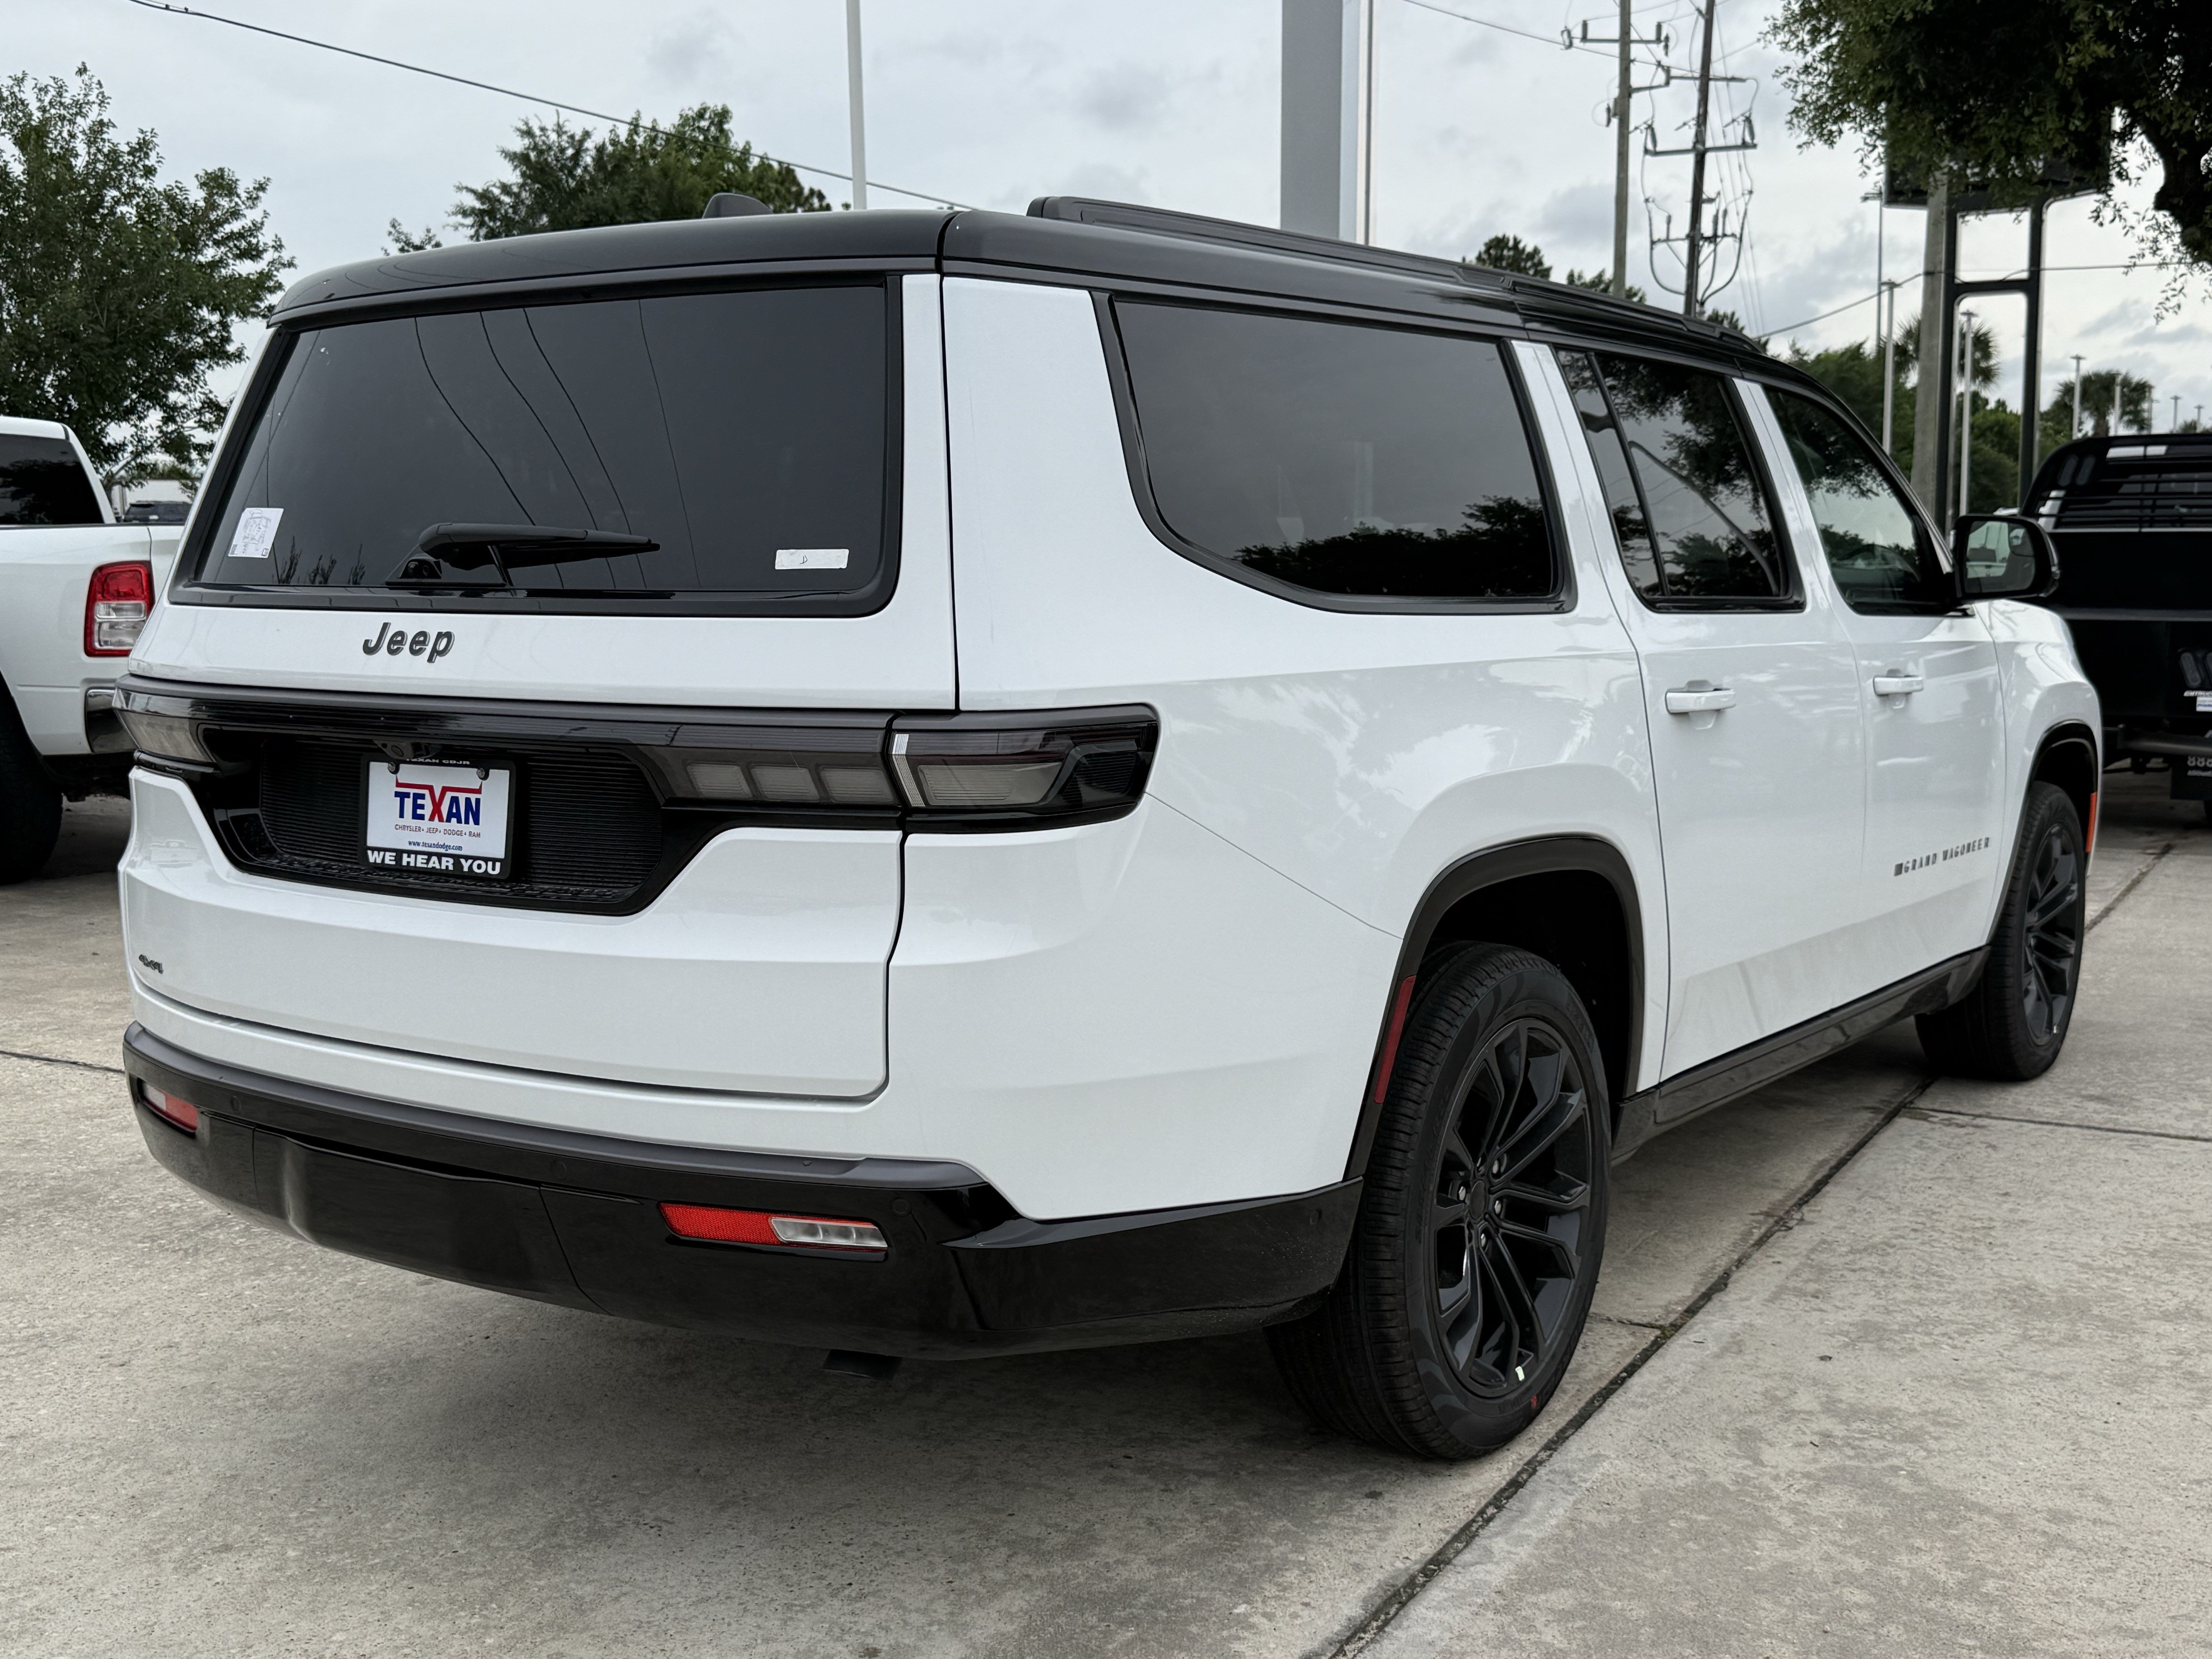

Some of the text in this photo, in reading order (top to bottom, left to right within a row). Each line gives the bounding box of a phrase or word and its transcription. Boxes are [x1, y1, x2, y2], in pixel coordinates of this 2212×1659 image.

[362, 622, 455, 663] Jeep
[394, 781, 482, 826] TEXAN
[395, 824, 422, 832] CHRYSLER
[443, 828, 464, 836] DODGE
[408, 840, 463, 852] www.texandodge.com
[1904, 837, 1990, 873] GRAND WAGONEER
[367, 850, 501, 875] WE HEAR YOU
